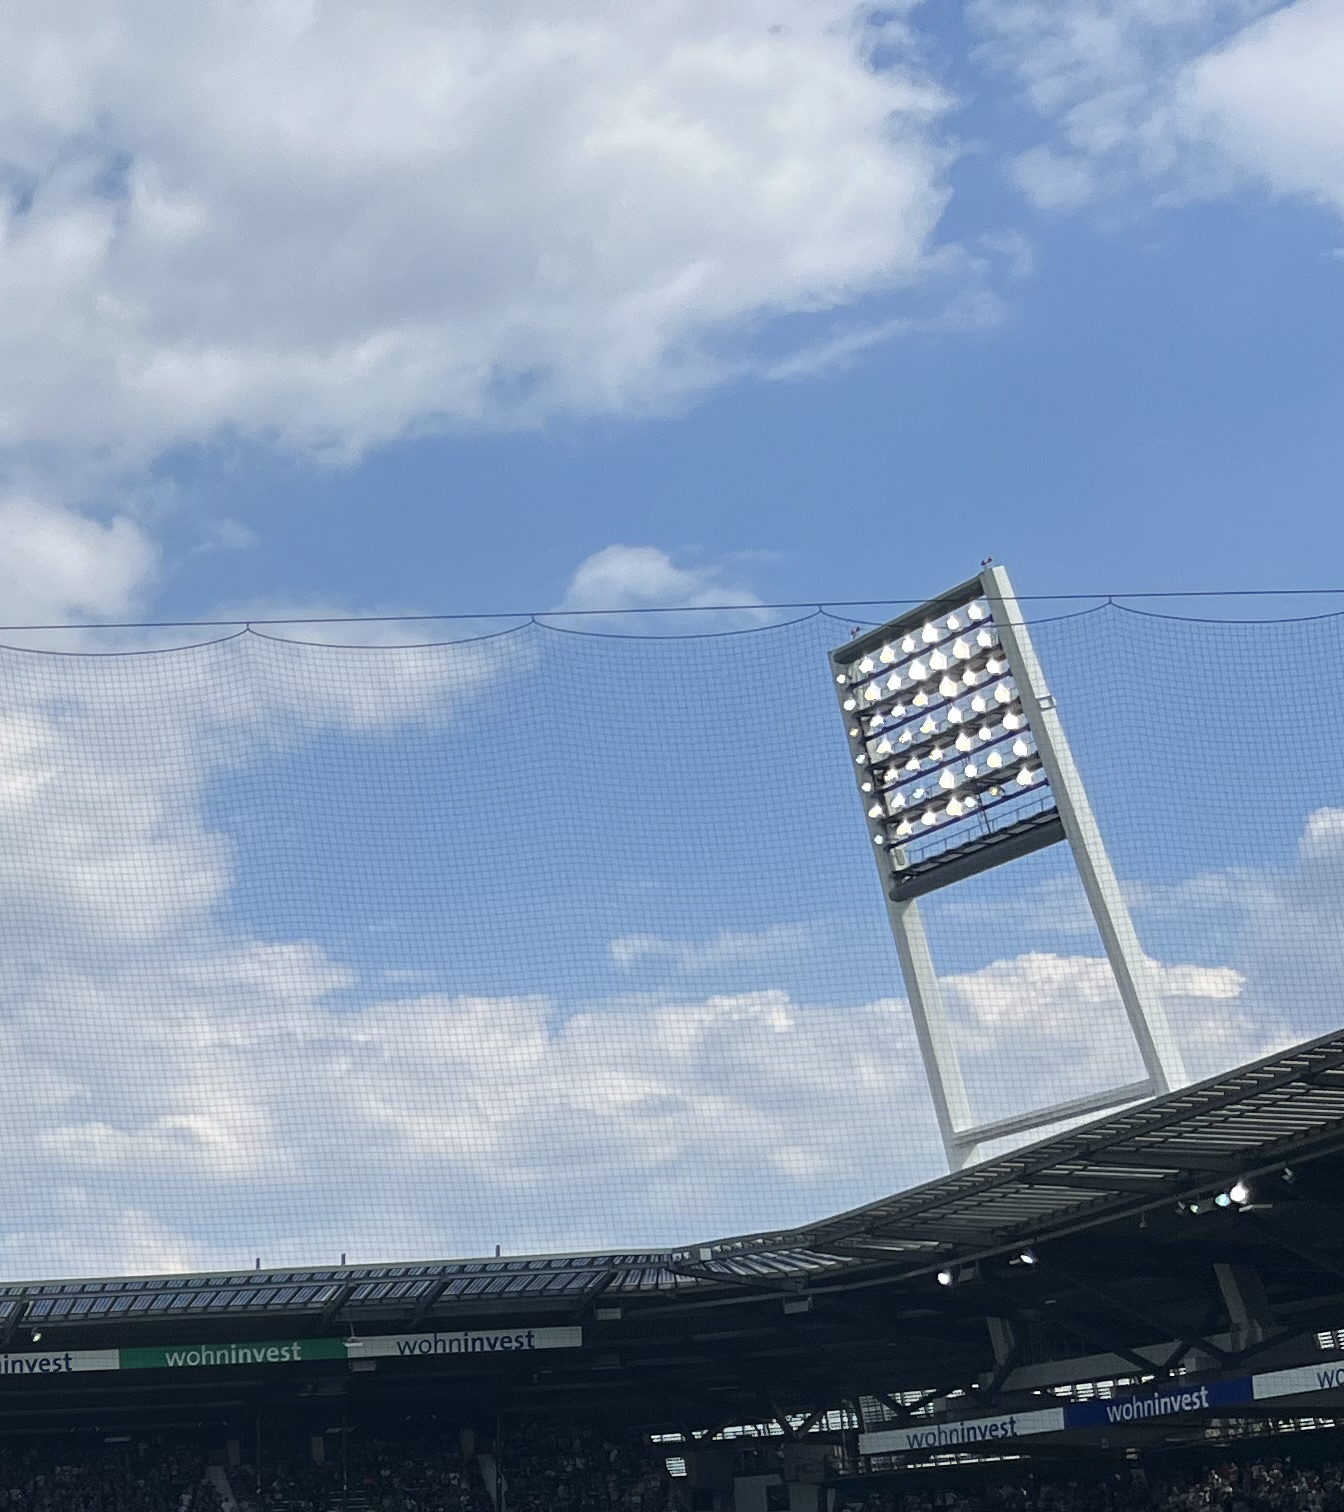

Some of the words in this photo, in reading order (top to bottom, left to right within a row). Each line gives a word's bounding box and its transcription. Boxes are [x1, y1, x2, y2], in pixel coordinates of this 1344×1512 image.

[165, 1342, 301, 1368] wohninvest
[397, 1329, 535, 1356] wohninvest
[1107, 1387, 1209, 1423] wohninvest
[907, 1416, 1017, 1449] wohninvest
